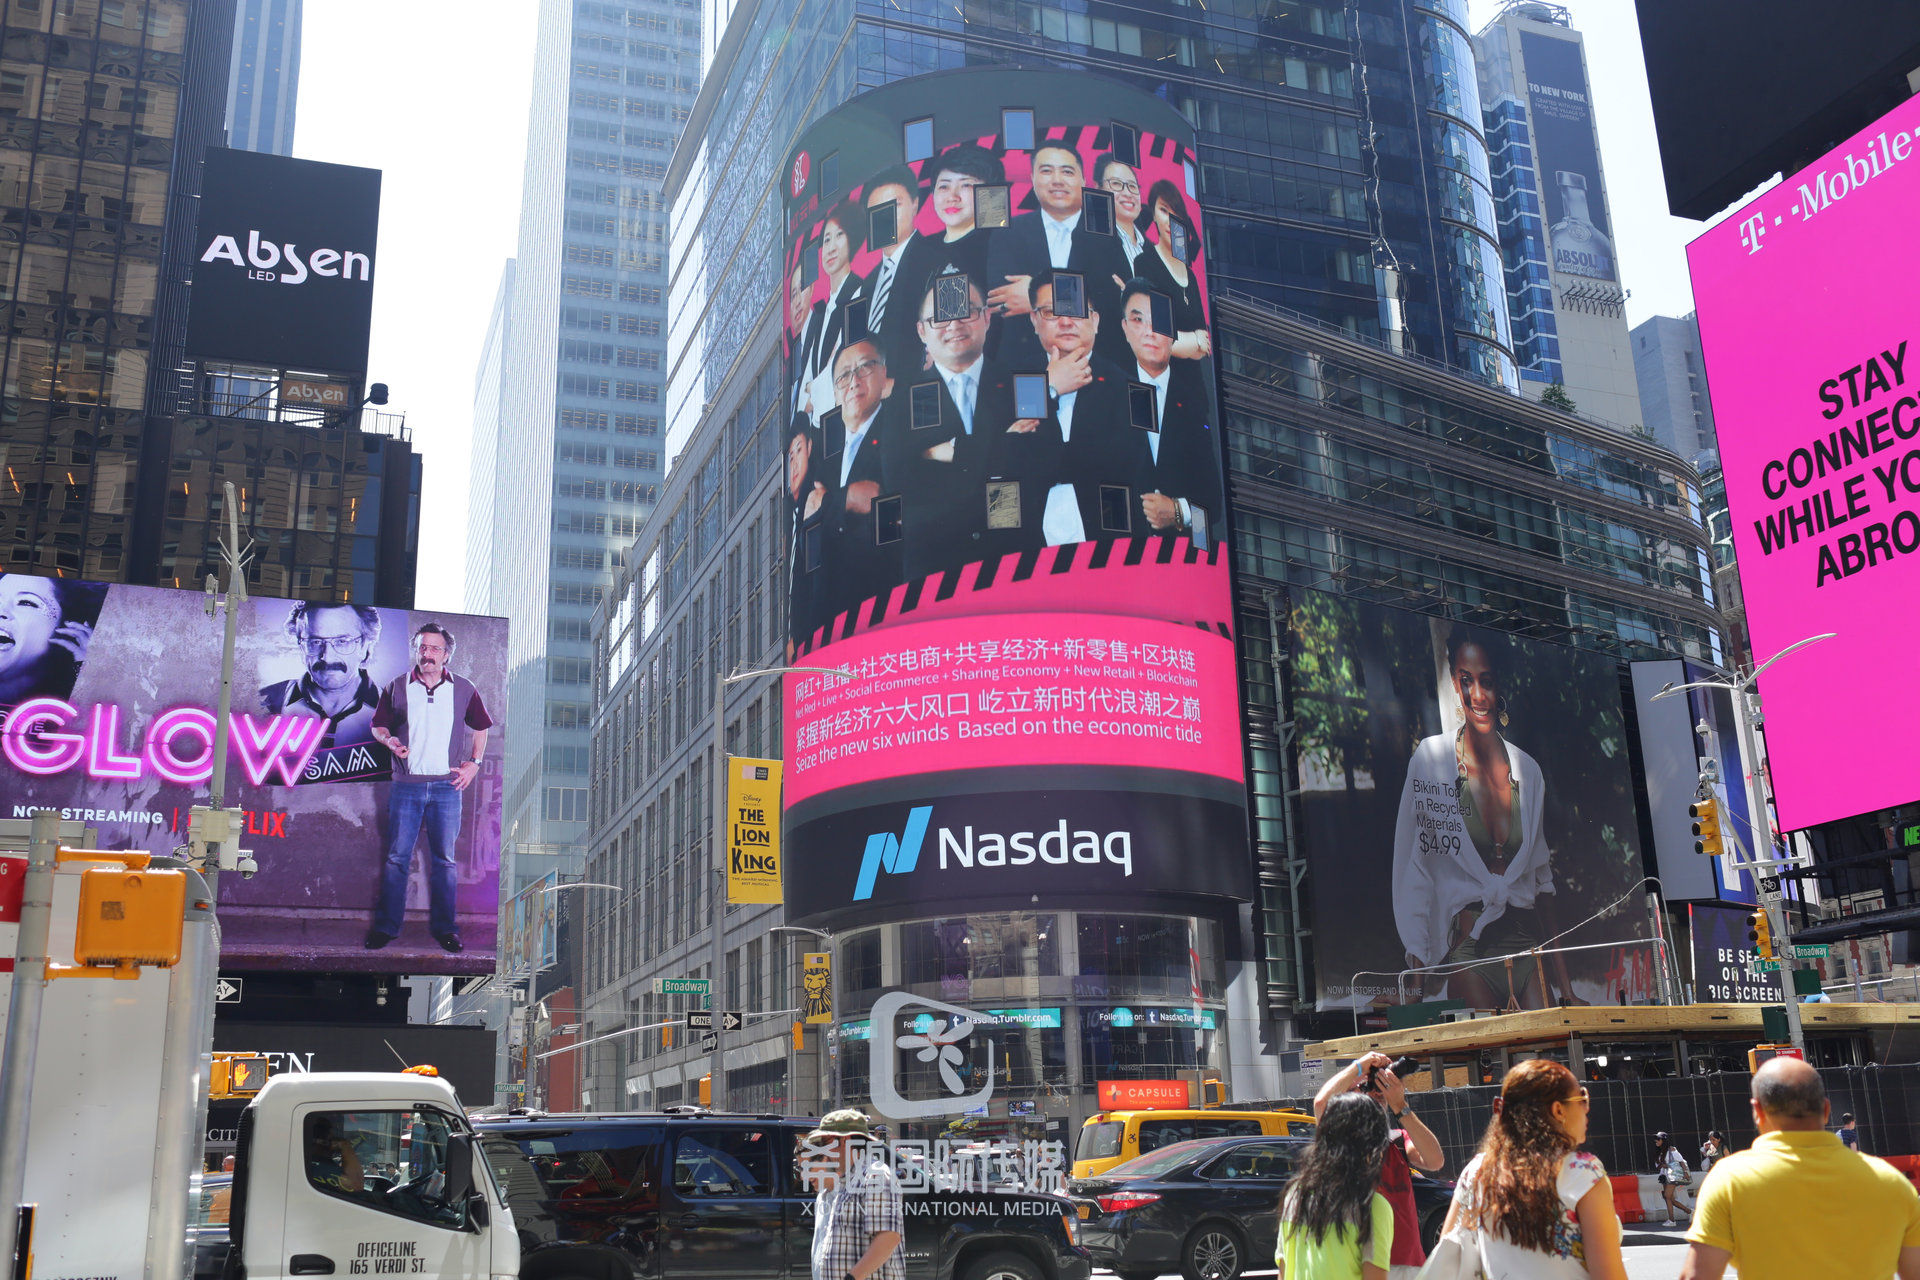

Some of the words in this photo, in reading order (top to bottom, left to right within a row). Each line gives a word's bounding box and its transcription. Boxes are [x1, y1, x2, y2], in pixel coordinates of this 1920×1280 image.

[1528, 82, 1540, 93] TO
[1540, 85, 1560, 98] NEW
[200, 230, 370, 285] Absen
[248, 269, 276, 282] LED
[1818, 340, 1908, 420] STAY
[286, 384, 344, 403] Absen
[1762, 391, 1920, 501] CONNEC
[1753, 474, 1871, 556] WHILE
[805, 700, 816, 715] Red
[823, 694, 837, 708] Live
[845, 682, 872, 700] Social
[874, 670, 939, 694] Ecommerce
[952, 666, 1000, 683] Sharing
[1003, 665, 1061, 679] Economy
[1074, 664, 1100, 678] New
[1103, 666, 1136, 680] Retail
[1147, 669, 1198, 689] Blockchain
[979, 686, 1202, 723] 屹立新时代浪潮之巅
[1, 697, 332, 788] GLOW
[795, 754, 818, 775] Seize
[819, 744, 837, 765] the
[840, 738, 869, 758] new
[872, 731, 893, 751] six
[896, 723, 949, 746] winds
[958, 716, 1017, 740] Based
[1022, 719, 1047, 735] on
[1052, 716, 1084, 734] the
[1087, 719, 1172, 740] economic
[1175, 724, 1203, 745] tide
[304, 746, 378, 781] SAM
[1413, 779, 1440, 796] Bikini
[1441, 783, 1461, 801] Top
[61, 807, 163, 825] STREAMING
[738, 808, 765, 822] THE
[1415, 797, 1424, 811] in
[1427, 797, 1472, 818] Recycled
[1416, 814, 1462, 833] Materials
[734, 823, 770, 847] LION
[1419, 830, 1461, 856] $4.99
[938, 818, 1133, 878] Nasdaq
[731, 847, 776, 874] KING
[1769, 891, 1781, 900] LANE
[1718, 948, 1734, 963] BE
[1796, 946, 1827, 958] Broadway
[1754, 961, 1762, 972] W
[1764, 961, 1773, 970] 43
[217, 985, 229, 996] AY
[665, 980, 707, 995] Broadway
[1326, 985, 1344, 995] NOW
[1354, 986, 1381, 995] STORES
[1382, 987, 1397, 995] AND
[1735, 986, 1782, 1001] SCREEN
[694, 1016, 711, 1025] ONE
[723, 1017, 734, 1025] AY
[1128, 1088, 1181, 1098] CAPSULE
[357, 1241, 417, 1258] OFFICELINE
[350, 1259, 369, 1275] 165
[375, 1258, 406, 1274] VERDI
[411, 1257, 427, 1273] ST.
